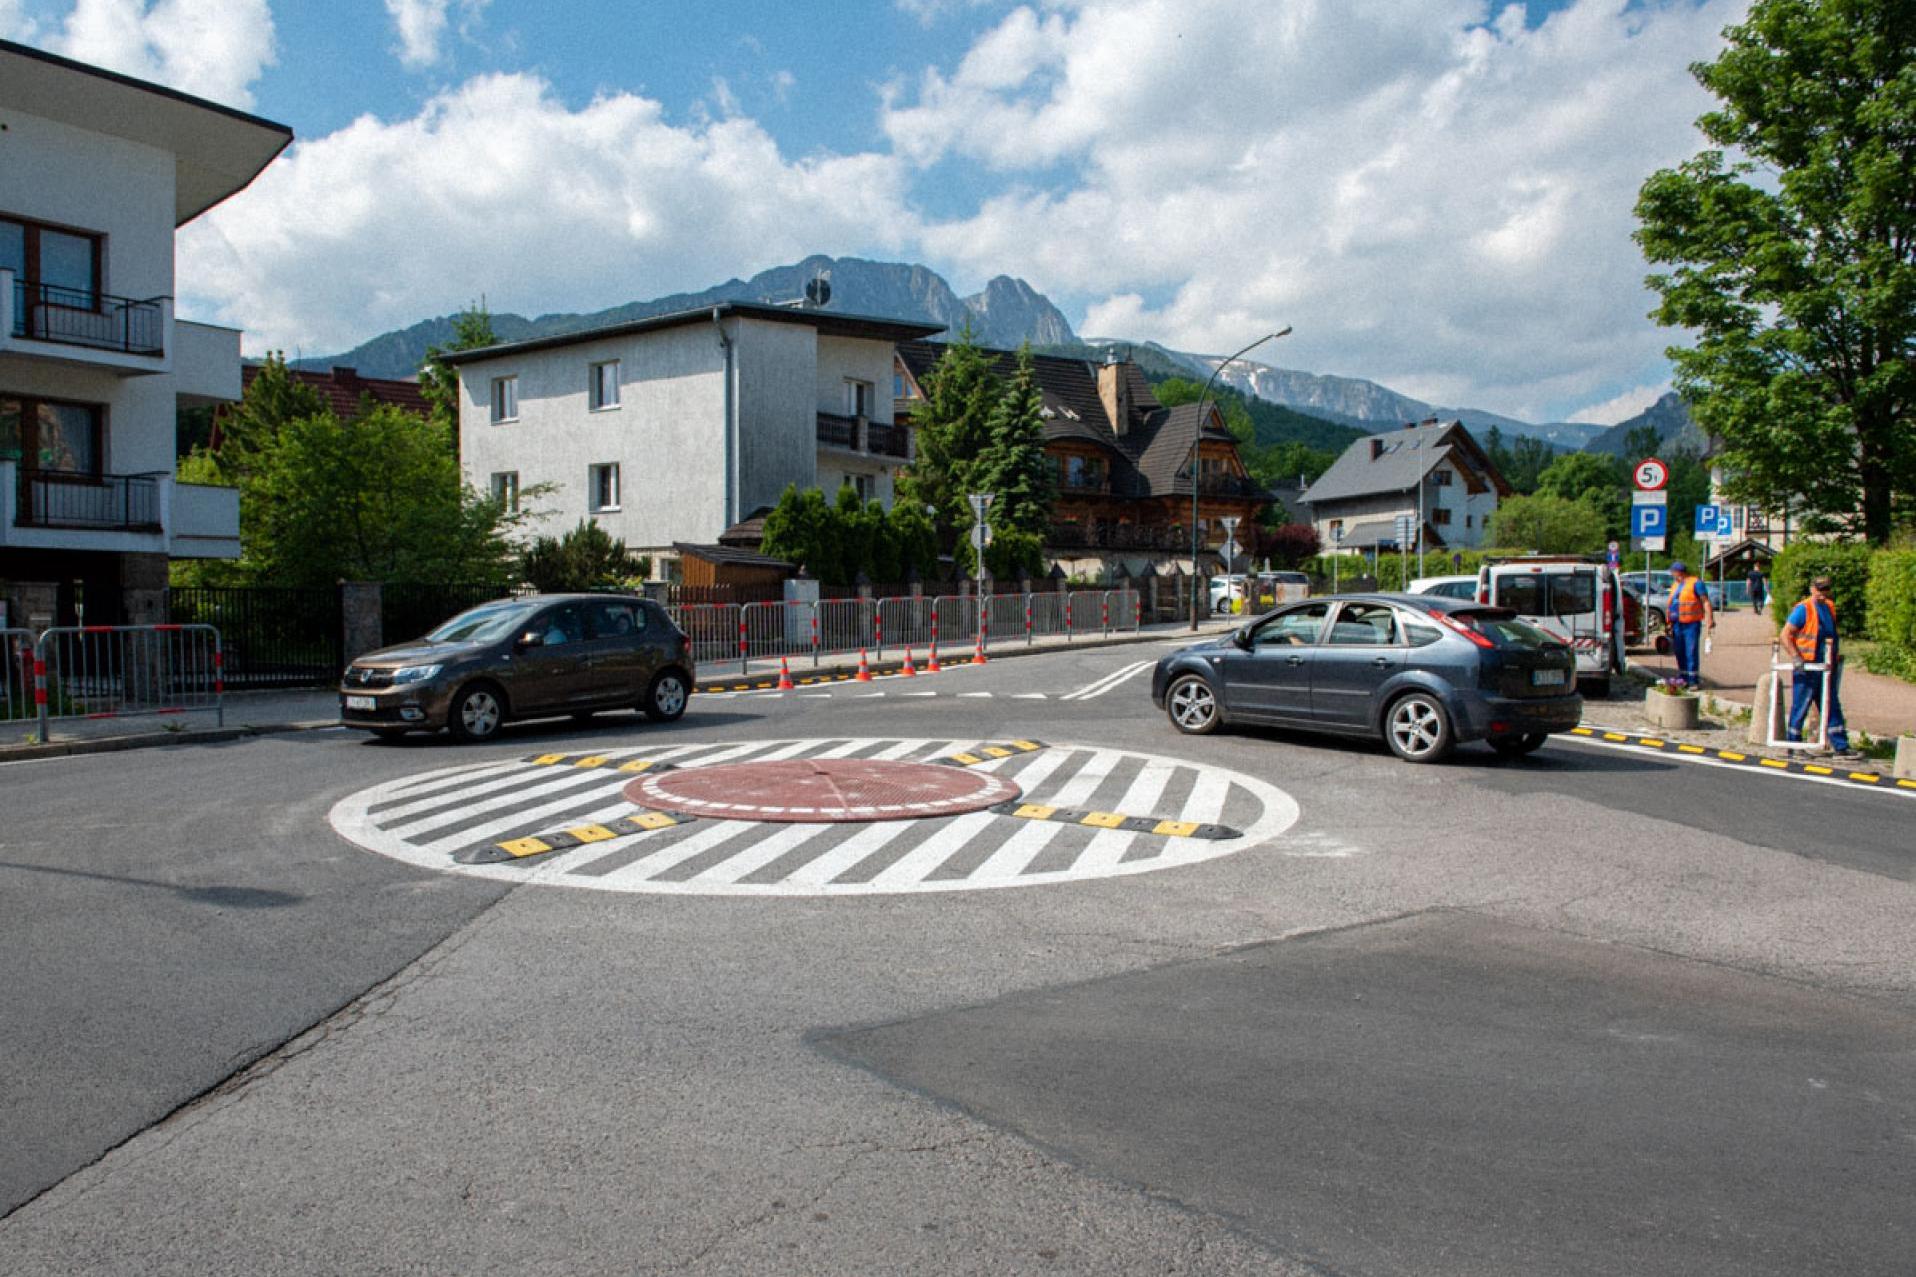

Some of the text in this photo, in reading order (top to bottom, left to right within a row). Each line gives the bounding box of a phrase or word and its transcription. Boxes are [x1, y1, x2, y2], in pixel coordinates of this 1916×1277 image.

[1640, 509, 1660, 533] P
[1701, 507, 1714, 525] P
[1717, 518, 1728, 533] P
